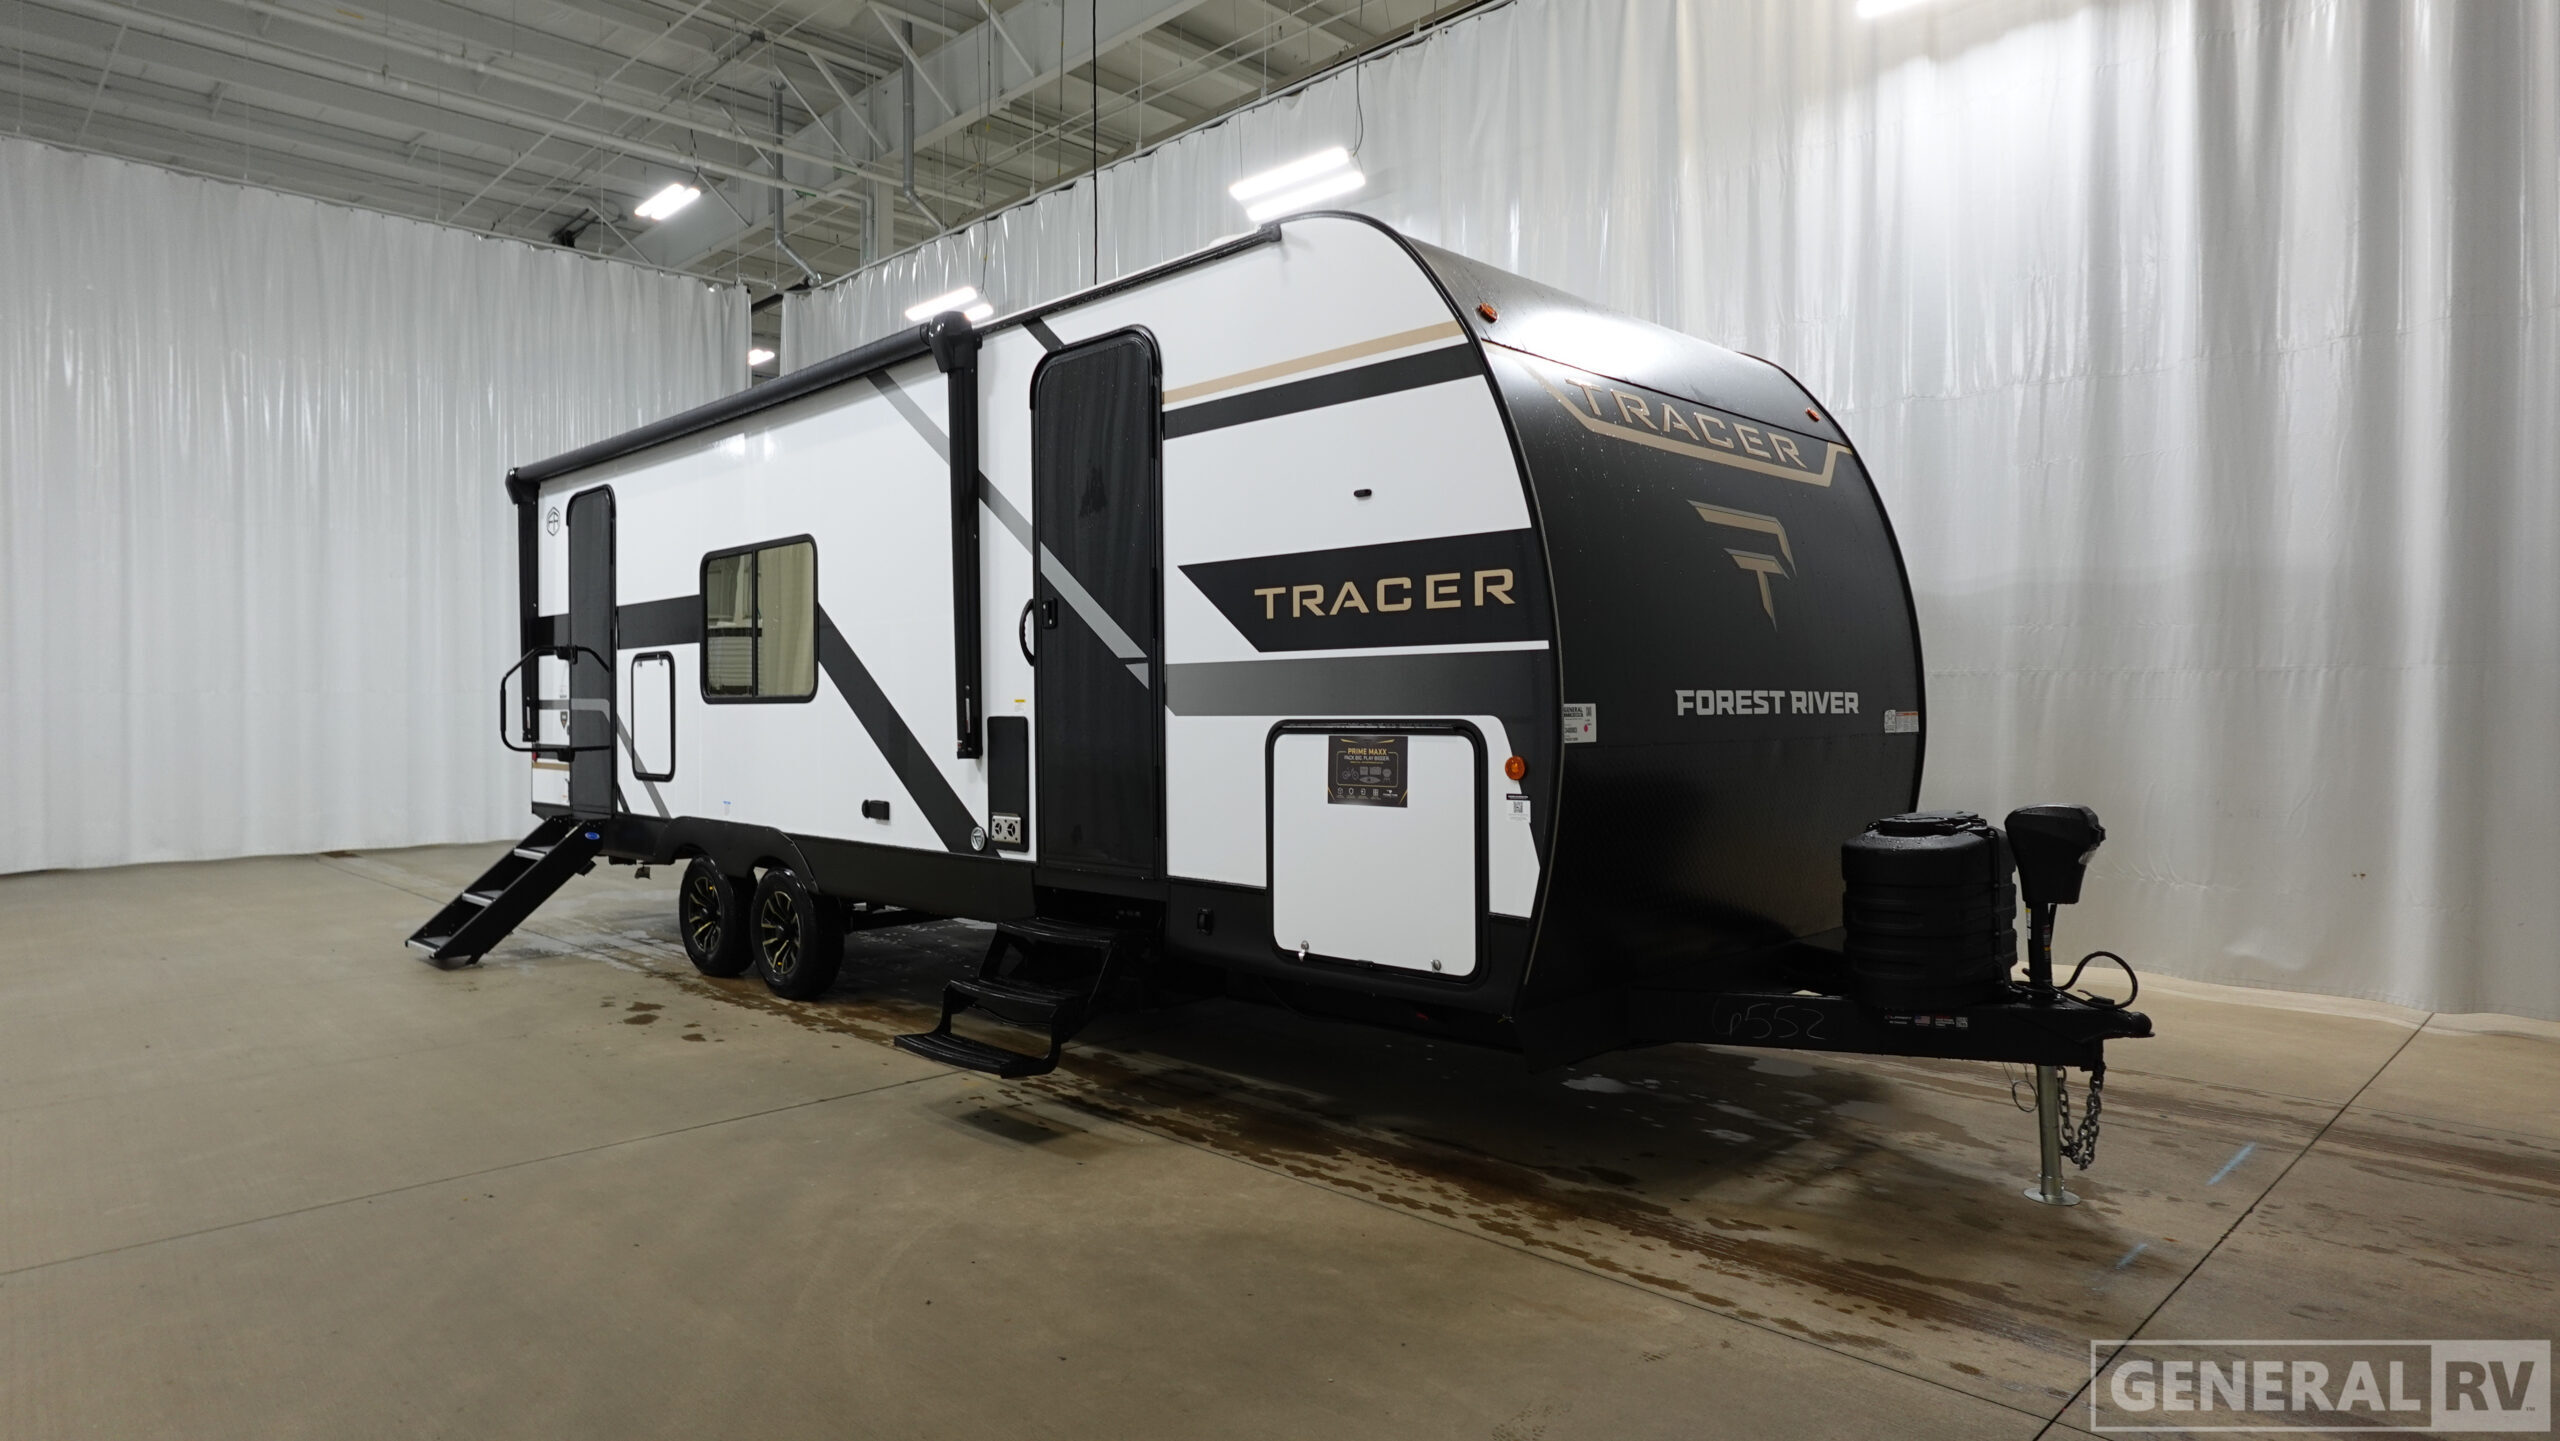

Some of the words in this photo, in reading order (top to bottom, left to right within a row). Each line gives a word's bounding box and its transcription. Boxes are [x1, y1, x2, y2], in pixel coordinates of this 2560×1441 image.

[1565, 378, 1807, 469] TRACER
[1254, 568, 1515, 619] TRACER
[1675, 690, 1785, 716] FOREST
[1790, 690, 1860, 714] RIVER
[1368, 748, 1388, 756] MAXX
